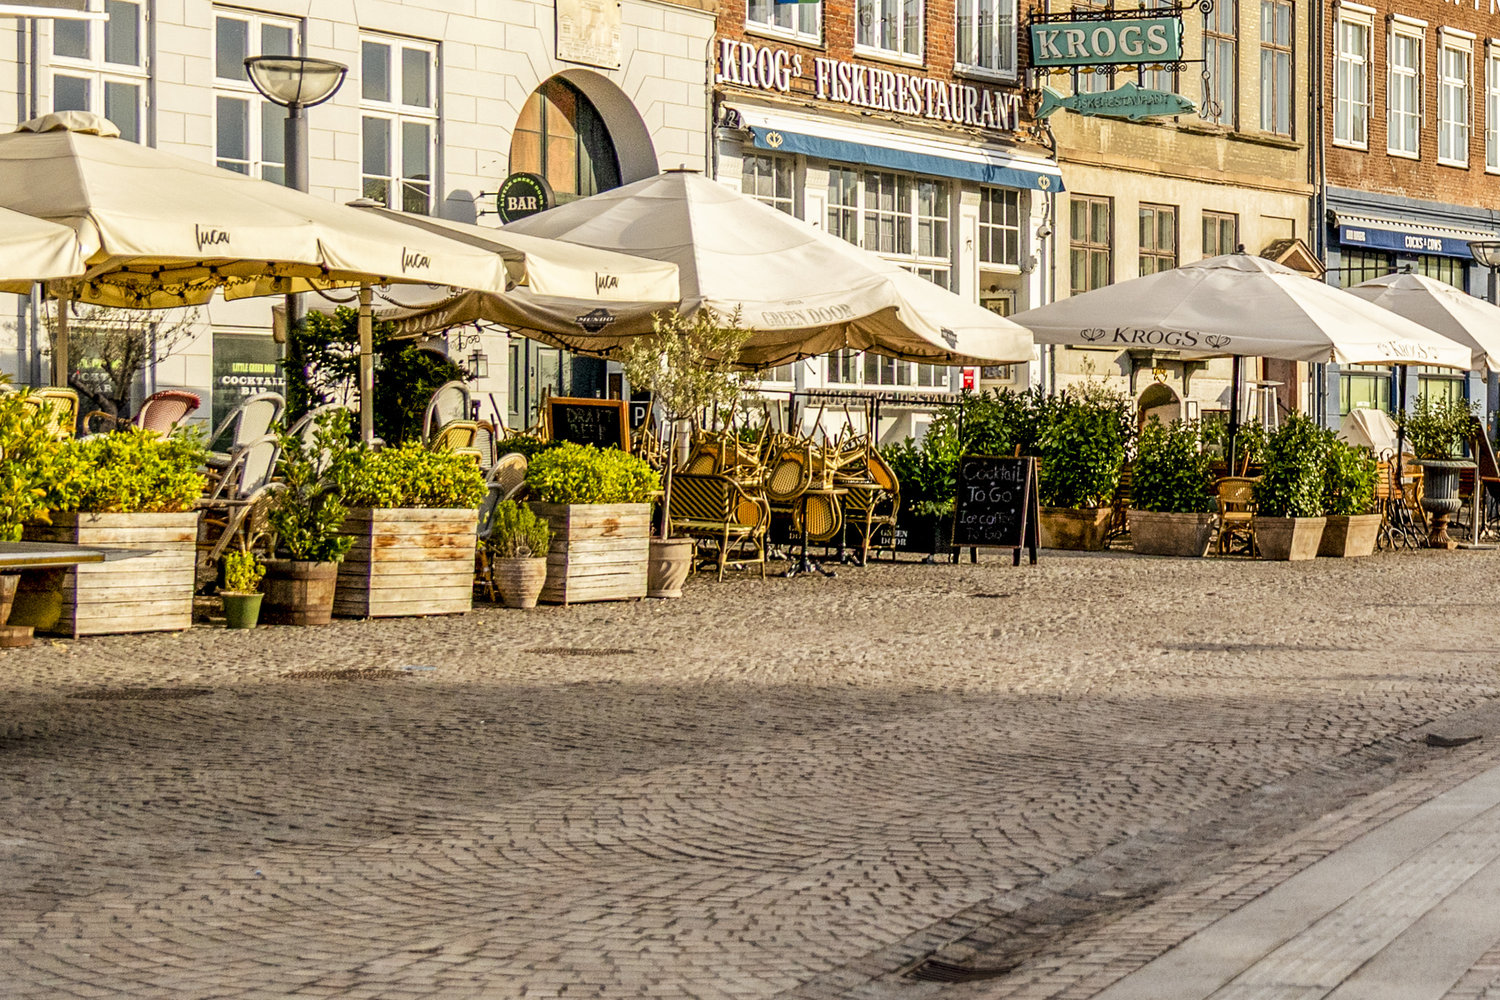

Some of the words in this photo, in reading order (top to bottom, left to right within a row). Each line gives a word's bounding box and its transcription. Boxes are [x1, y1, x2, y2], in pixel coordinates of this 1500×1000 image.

[1036, 24, 1169, 59] KROGS
[815, 57, 1023, 132] FISKERESTAURANT
[507, 196, 537, 211] BAR
[761, 309, 807, 326] GREEN
[807, 303, 856, 323] DOOR
[1112, 327, 1200, 347] KROGS
[222, 375, 286, 386] COCKTAIL
[967, 486, 986, 502] To
[989, 486, 1012, 502] Go
